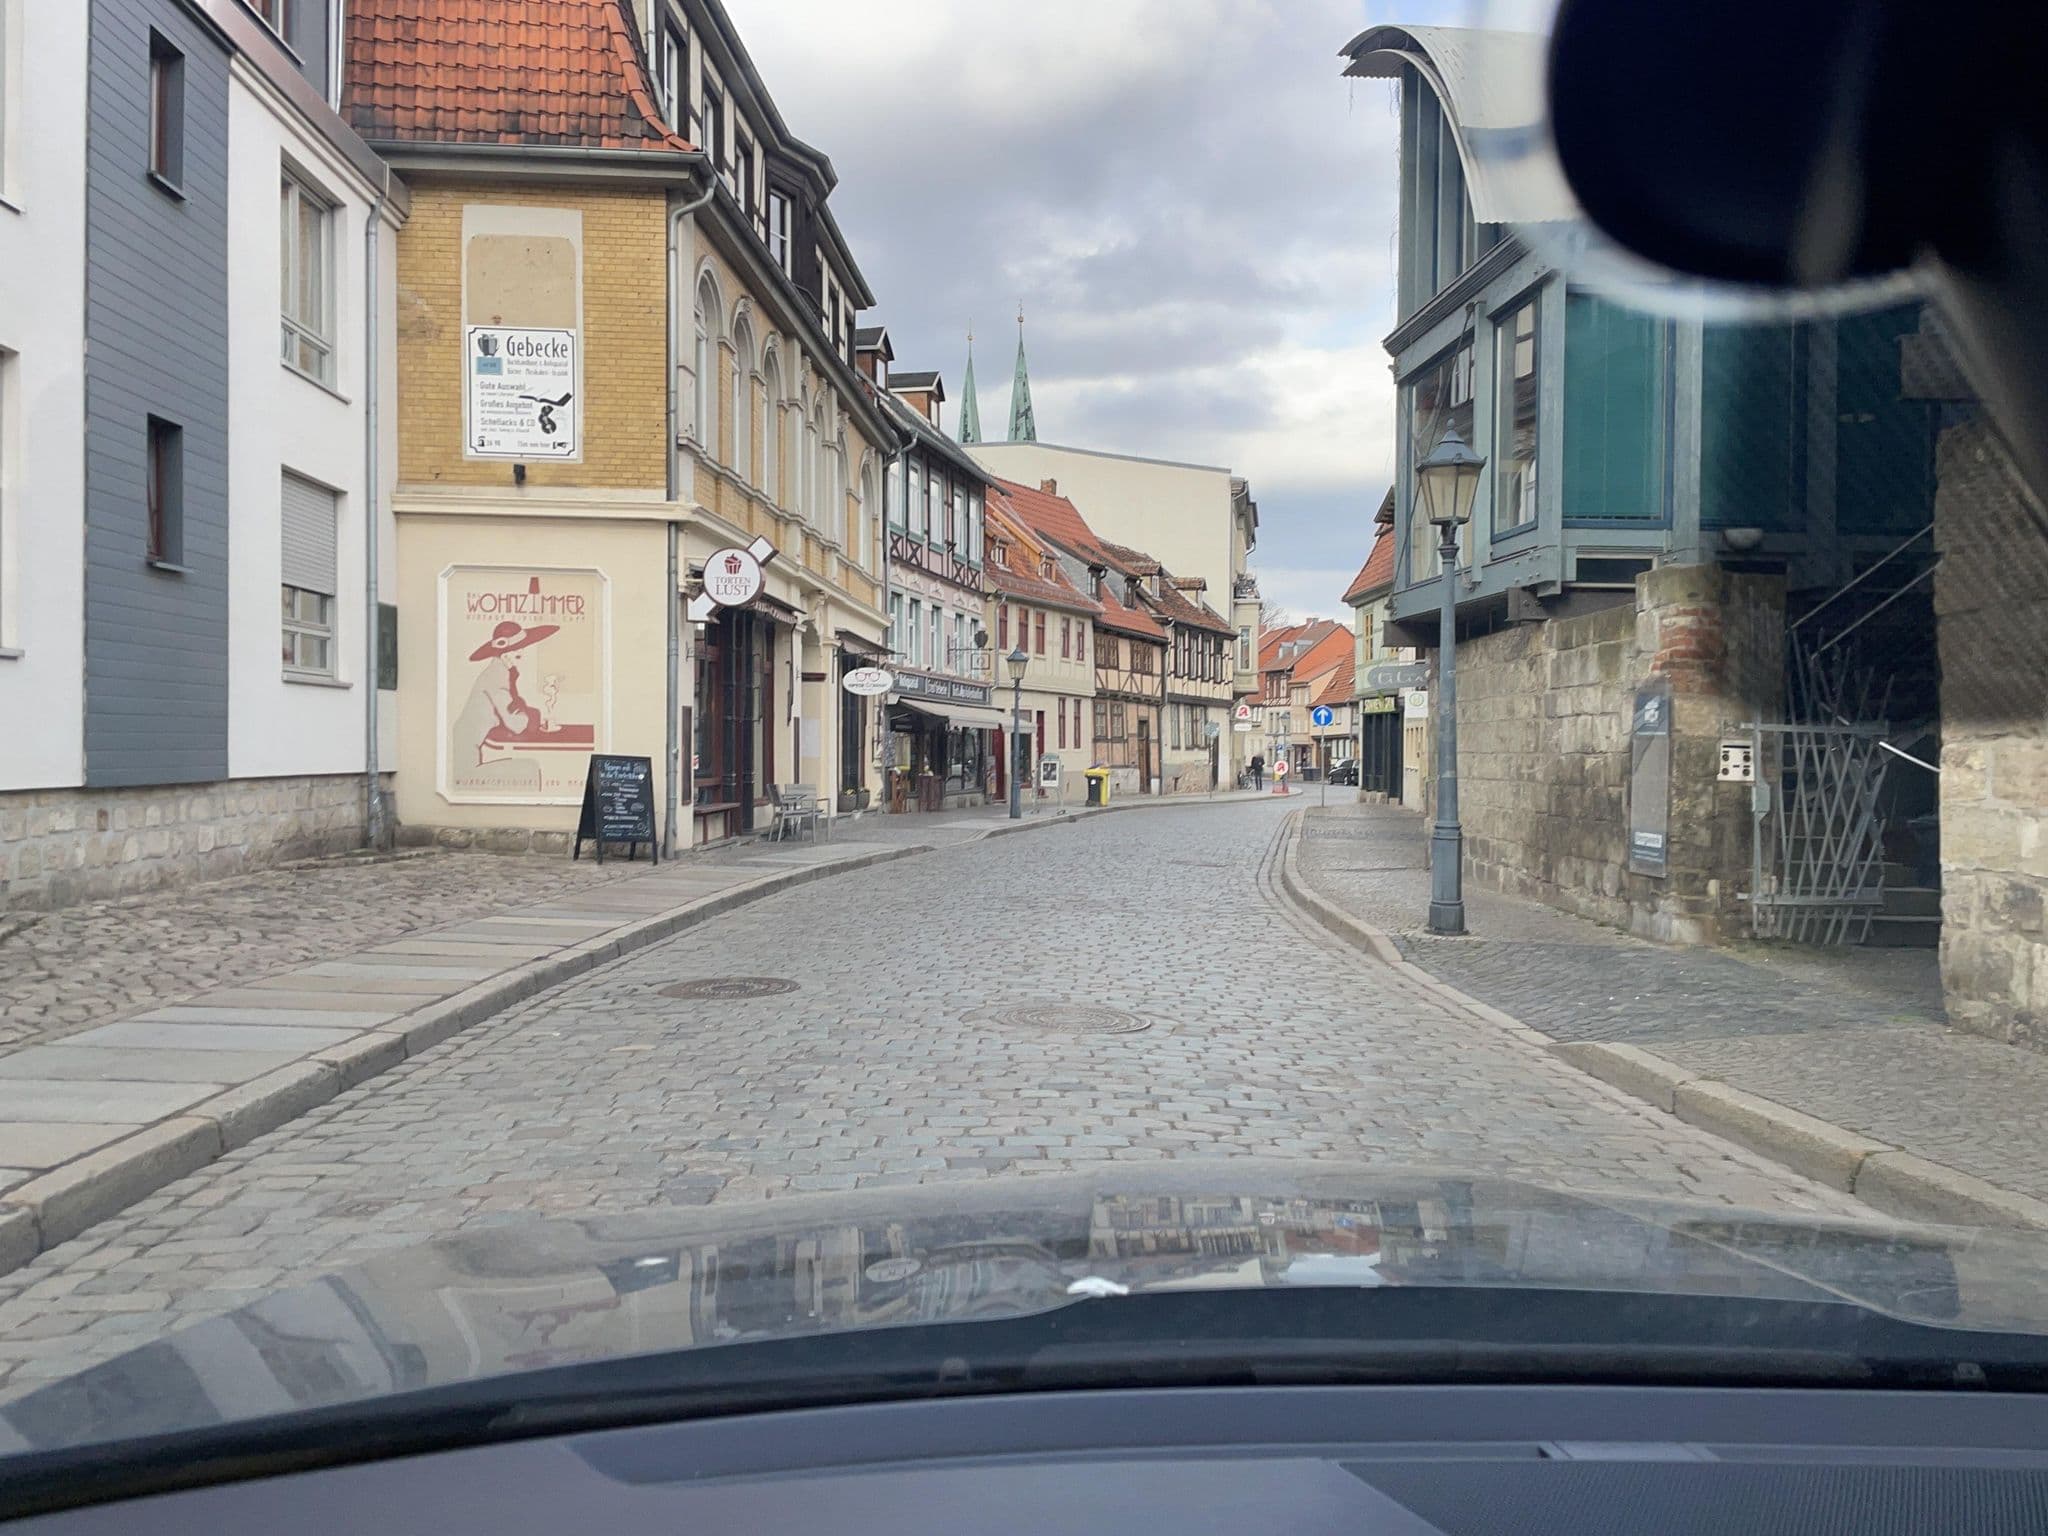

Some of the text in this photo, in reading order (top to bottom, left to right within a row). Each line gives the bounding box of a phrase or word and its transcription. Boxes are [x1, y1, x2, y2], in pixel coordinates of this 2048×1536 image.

[507, 336, 568, 358] Gebecke
[715, 584, 751, 596] LUST
[466, 593, 585, 615] WOHNZIMMER
